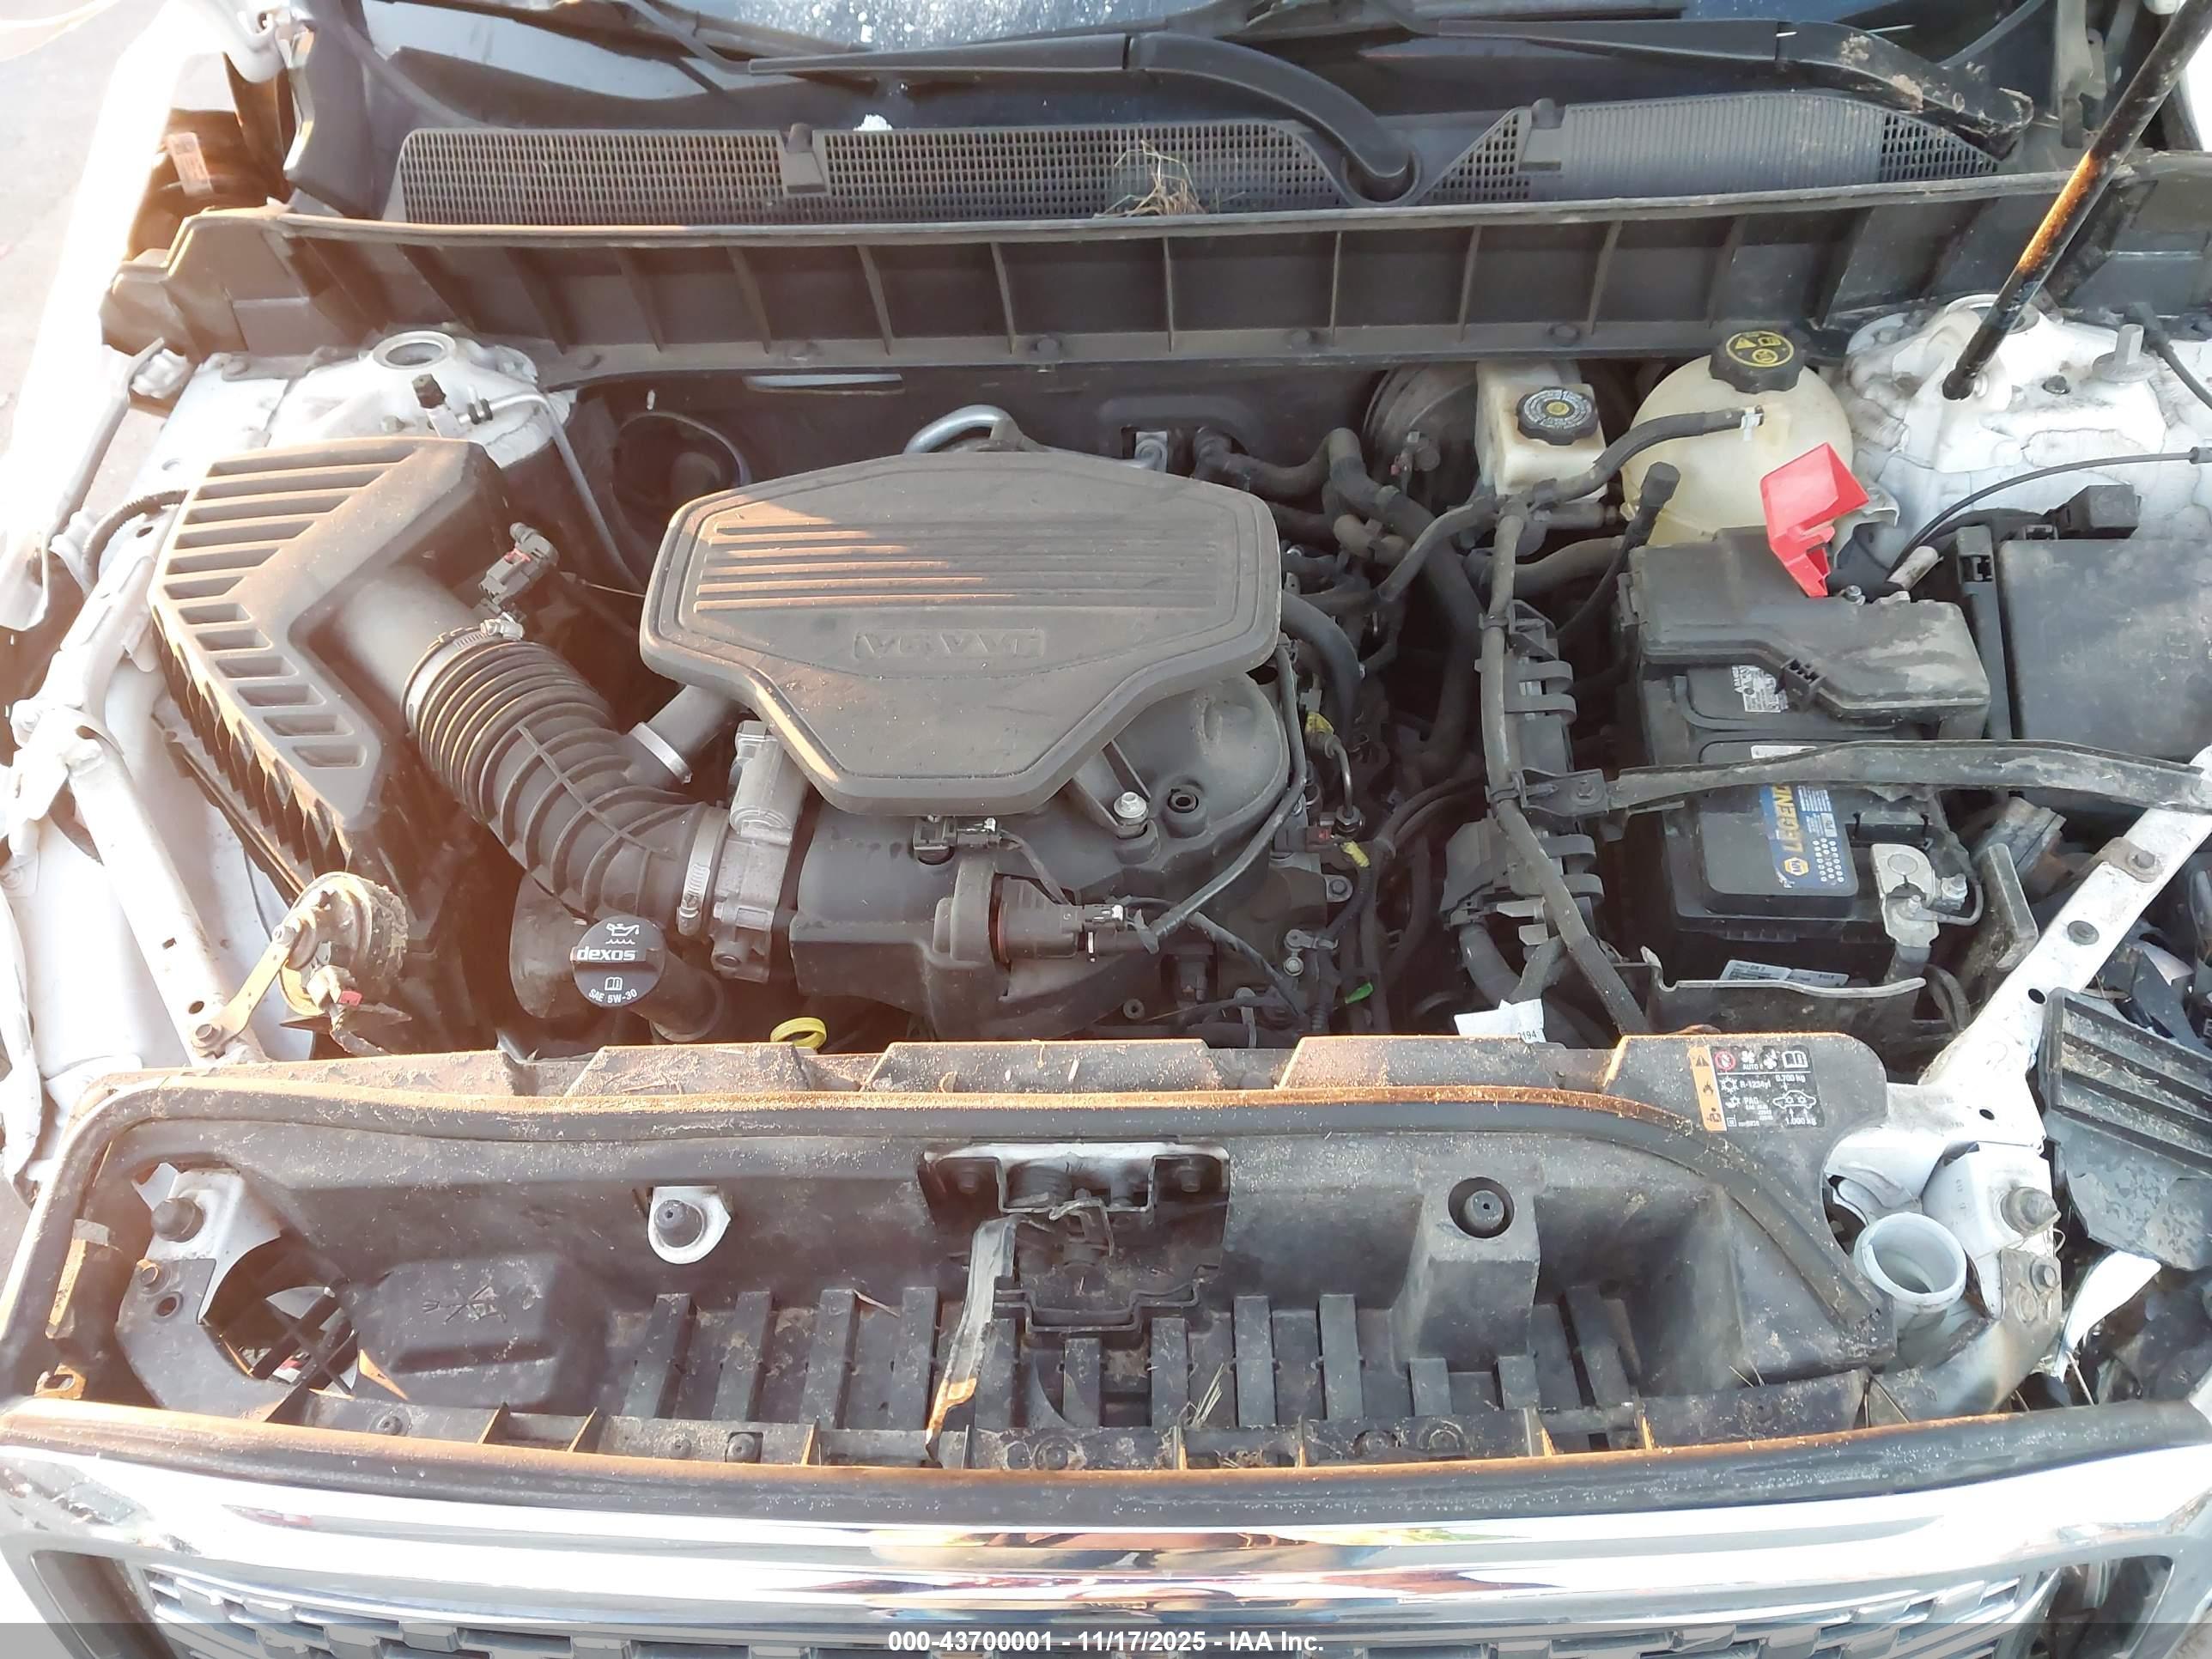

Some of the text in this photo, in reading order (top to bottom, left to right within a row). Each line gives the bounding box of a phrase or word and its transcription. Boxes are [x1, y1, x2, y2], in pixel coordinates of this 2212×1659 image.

[577, 945, 636, 961] dexos
[589, 988, 638, 1004] SAE 5W-30
